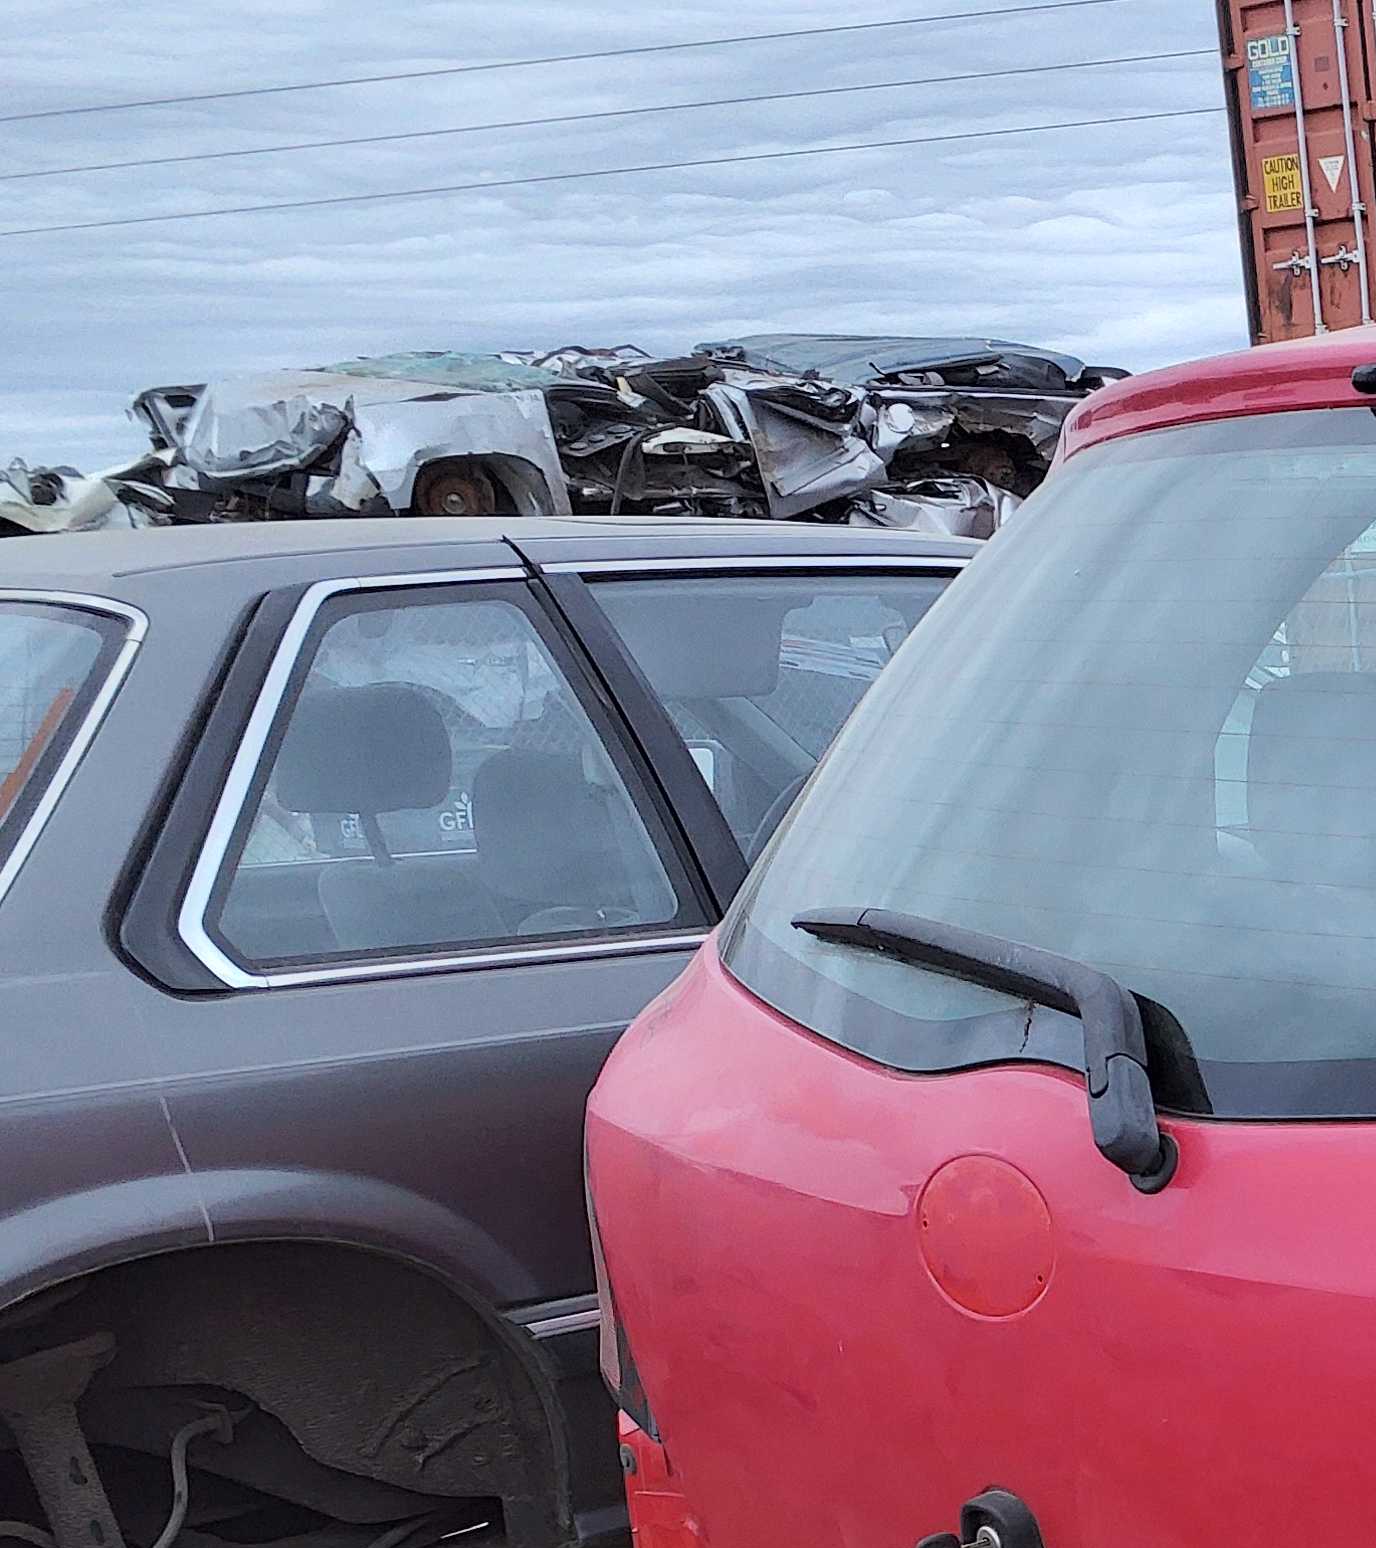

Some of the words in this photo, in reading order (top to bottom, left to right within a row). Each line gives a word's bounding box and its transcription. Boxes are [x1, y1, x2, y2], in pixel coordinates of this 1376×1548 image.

[1247, 36, 1290, 60] GOLD
[1264, 156, 1299, 175] CAUTION
[1272, 174, 1295, 192] HIGH
[1267, 191, 1302, 210] TRAILER
